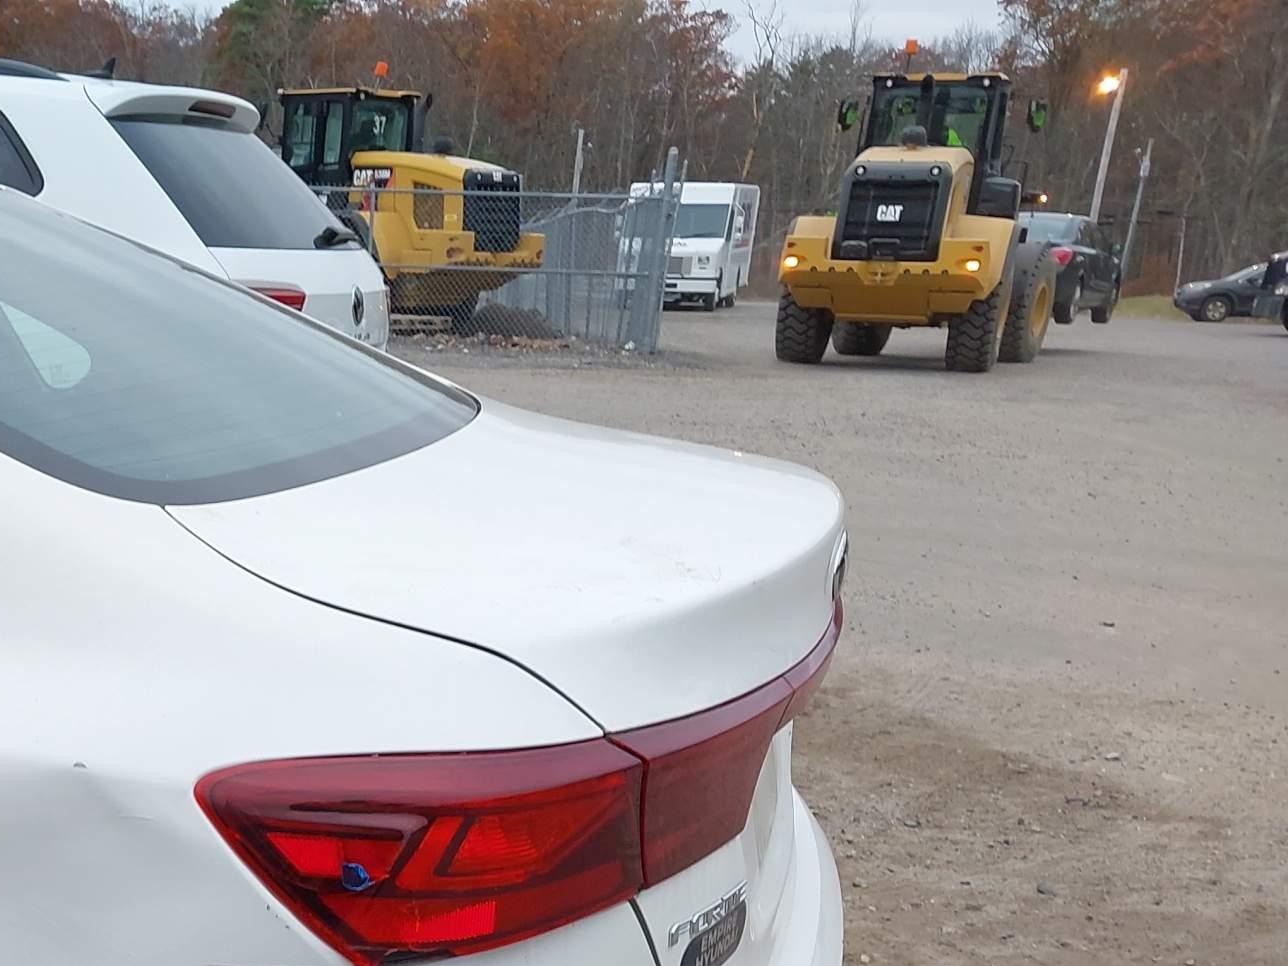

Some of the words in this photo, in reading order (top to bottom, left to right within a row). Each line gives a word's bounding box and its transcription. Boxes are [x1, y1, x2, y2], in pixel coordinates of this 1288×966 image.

[372, 115, 386, 134] 37
[353, 168, 373, 186] CAT
[876, 204, 903, 221] CAT
[700, 912, 738, 951] EMPIRE
